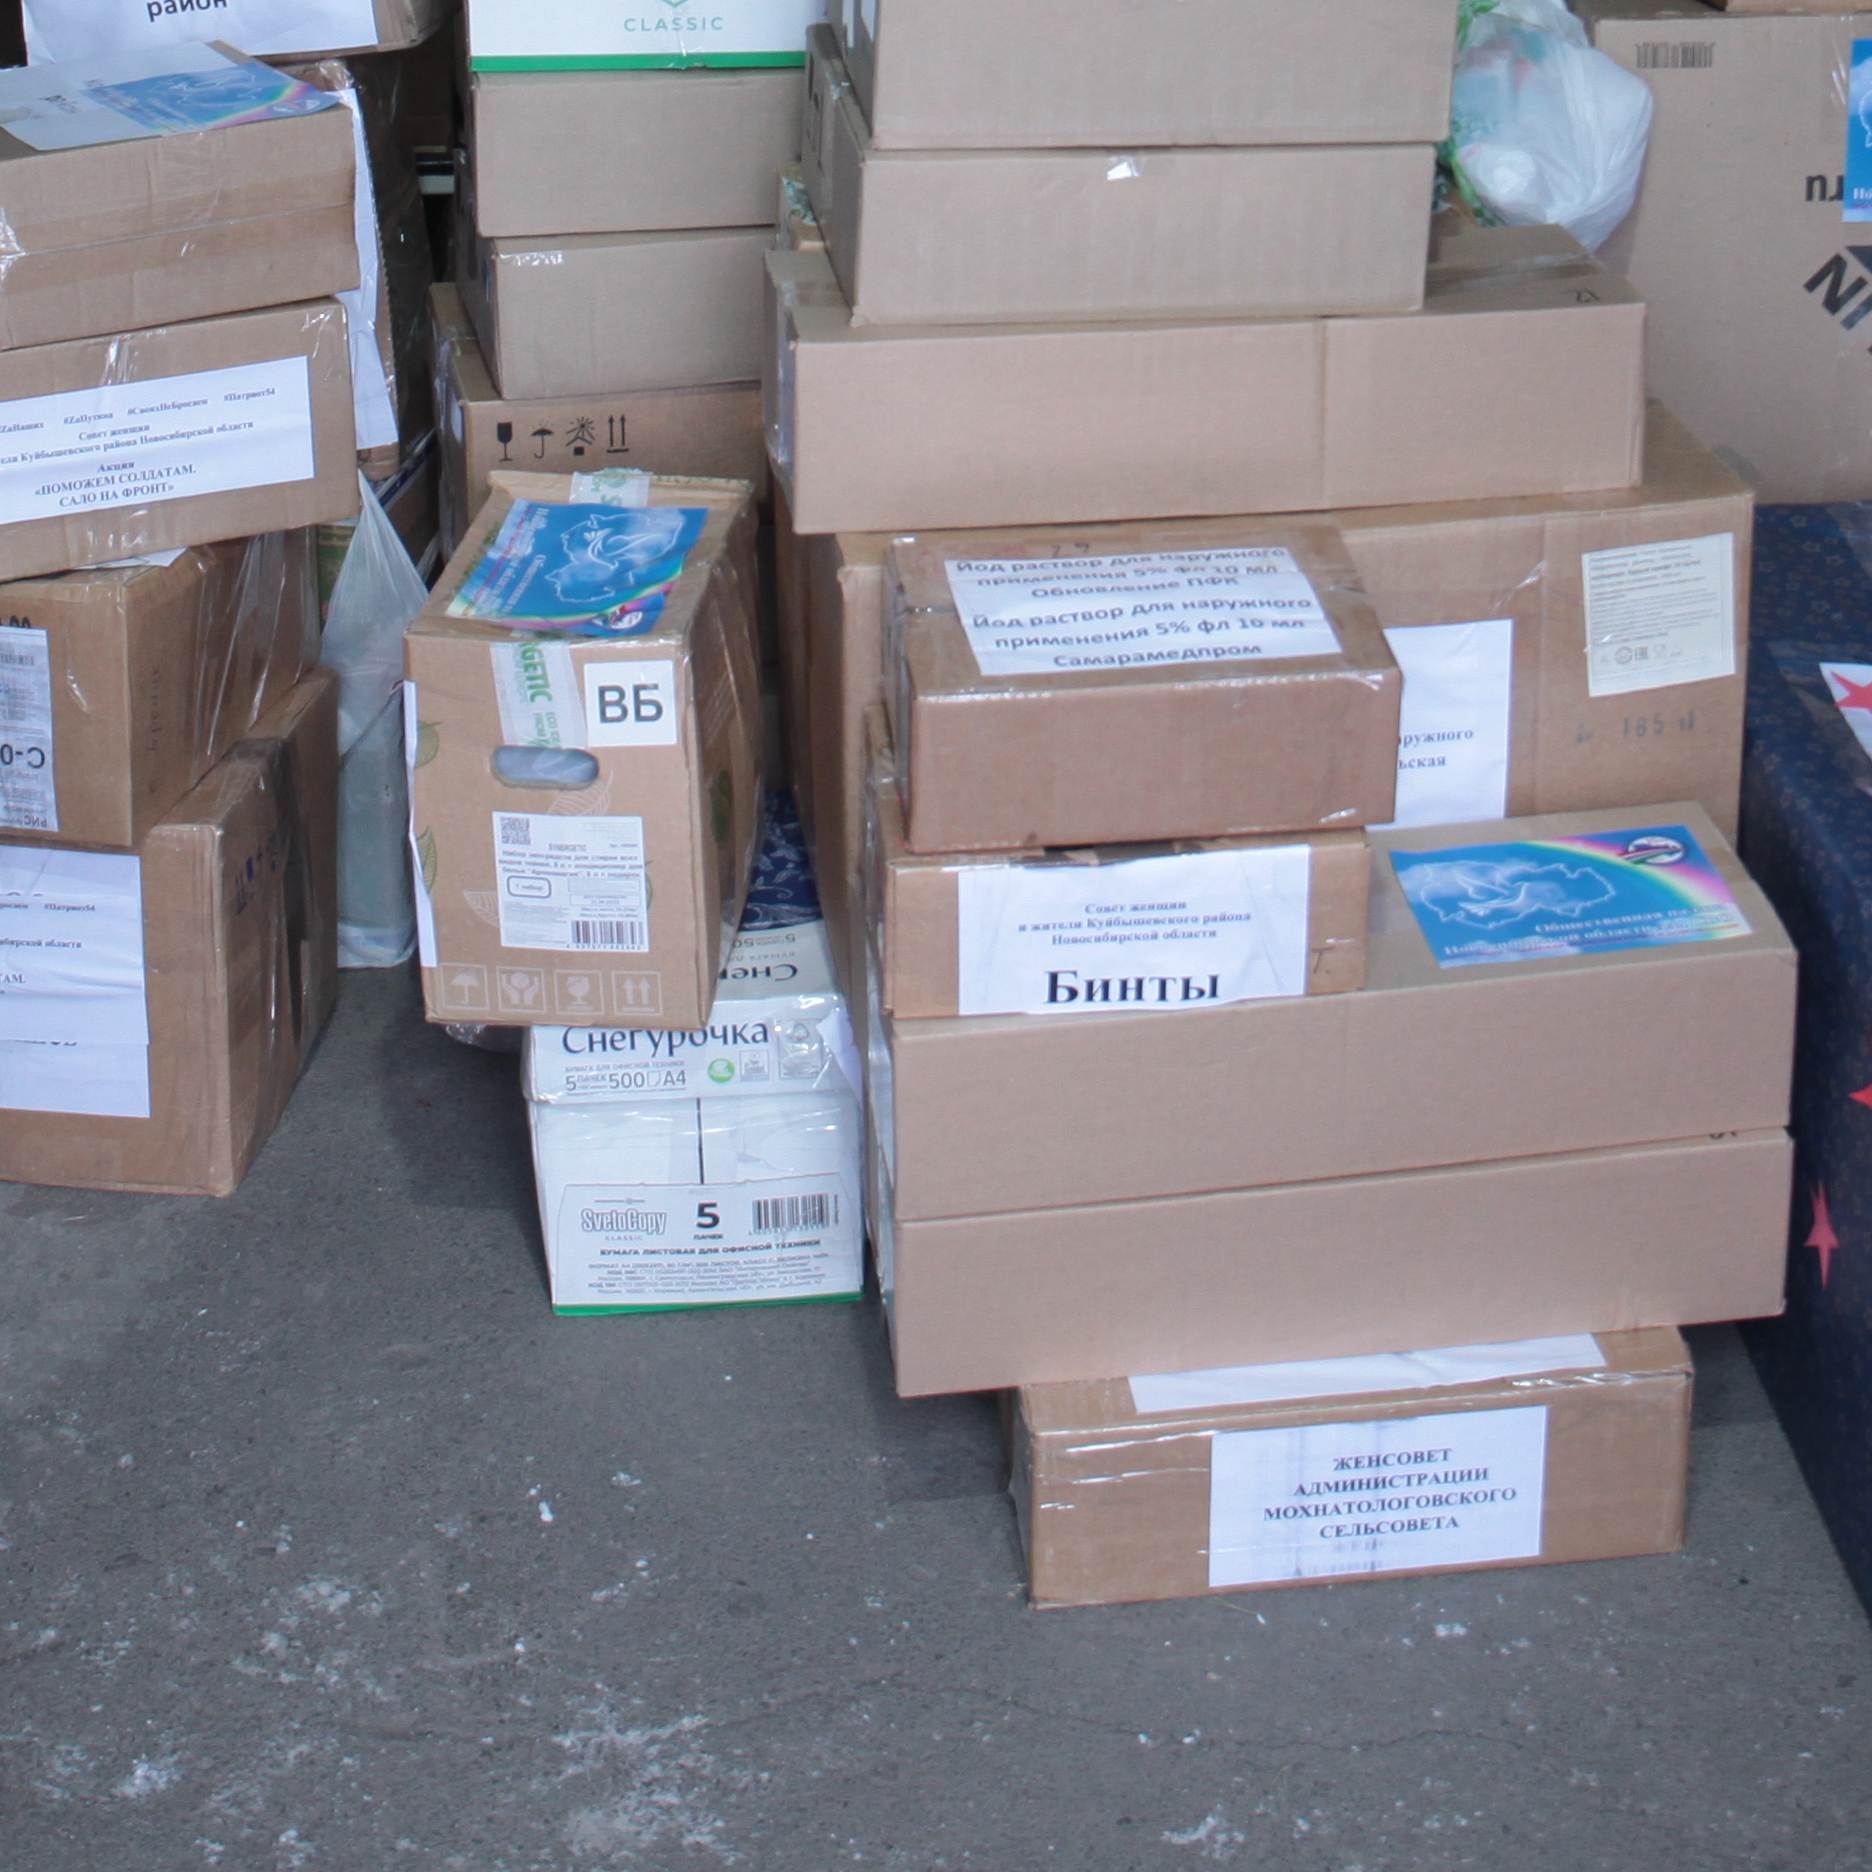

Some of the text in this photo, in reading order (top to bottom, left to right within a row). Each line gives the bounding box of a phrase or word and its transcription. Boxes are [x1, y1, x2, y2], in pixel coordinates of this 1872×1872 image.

[623, 16, 725, 32] CLASSIC
[20, 420, 255, 464] Куйбышевского района Новосибирской области
[78, 424, 151, 442] Совет женщин
[34, 463, 198, 497] «ПОМОЖЕМ СОЛДАТАМ.
[97, 461, 136, 473] Акция
[58, 482, 175, 508] САЛО НА ФРОНТ»
[1011, 548, 1286, 574] раствор для наружного
[977, 565, 1167, 587] применения 5%
[1030, 578, 1181, 600] Обновление
[971, 596, 1314, 629] Йод раствор для наружного
[994, 617, 1232, 652] применения 5% фл
[1053, 642, 1264, 669] Самарамедпром
[597, 683, 664, 725] ВБ
[1397, 754, 1447, 770] ьская
[22, 815, 48, 828] РИС
[1084, 900, 1188, 915] Совет женщин
[1029, 910, 1254, 933] жители Куйбышевского района
[1050, 926, 1218, 946] Новосибирской области
[1042, 968, 1221, 1005] Бинты
[561, 1021, 770, 1059] Снегурочка
[612, 1059, 685, 1070] ОФИСНОЙ ТЕХНИКИ
[565, 1069, 687, 1091] 5 500 A4
[581, 1208, 667, 1236] SvetoCopy
[695, 1202, 721, 1229] 5
[599, 1238, 821, 1256] БУМАГА ЛИСТОВАЯ ДЛЯ ОФИСНОЙ ТЕХНИКИ
[1331, 1447, 1452, 1473] ЖЕНСОВЕТ
[1292, 1465, 1491, 1499] АДМИНИСТРАЦИИ
[1261, 1486, 1518, 1522] МОХНАТОЛОГОВСКОГО
[1318, 1515, 1461, 1540] СЕЛЬСОВЕТА
